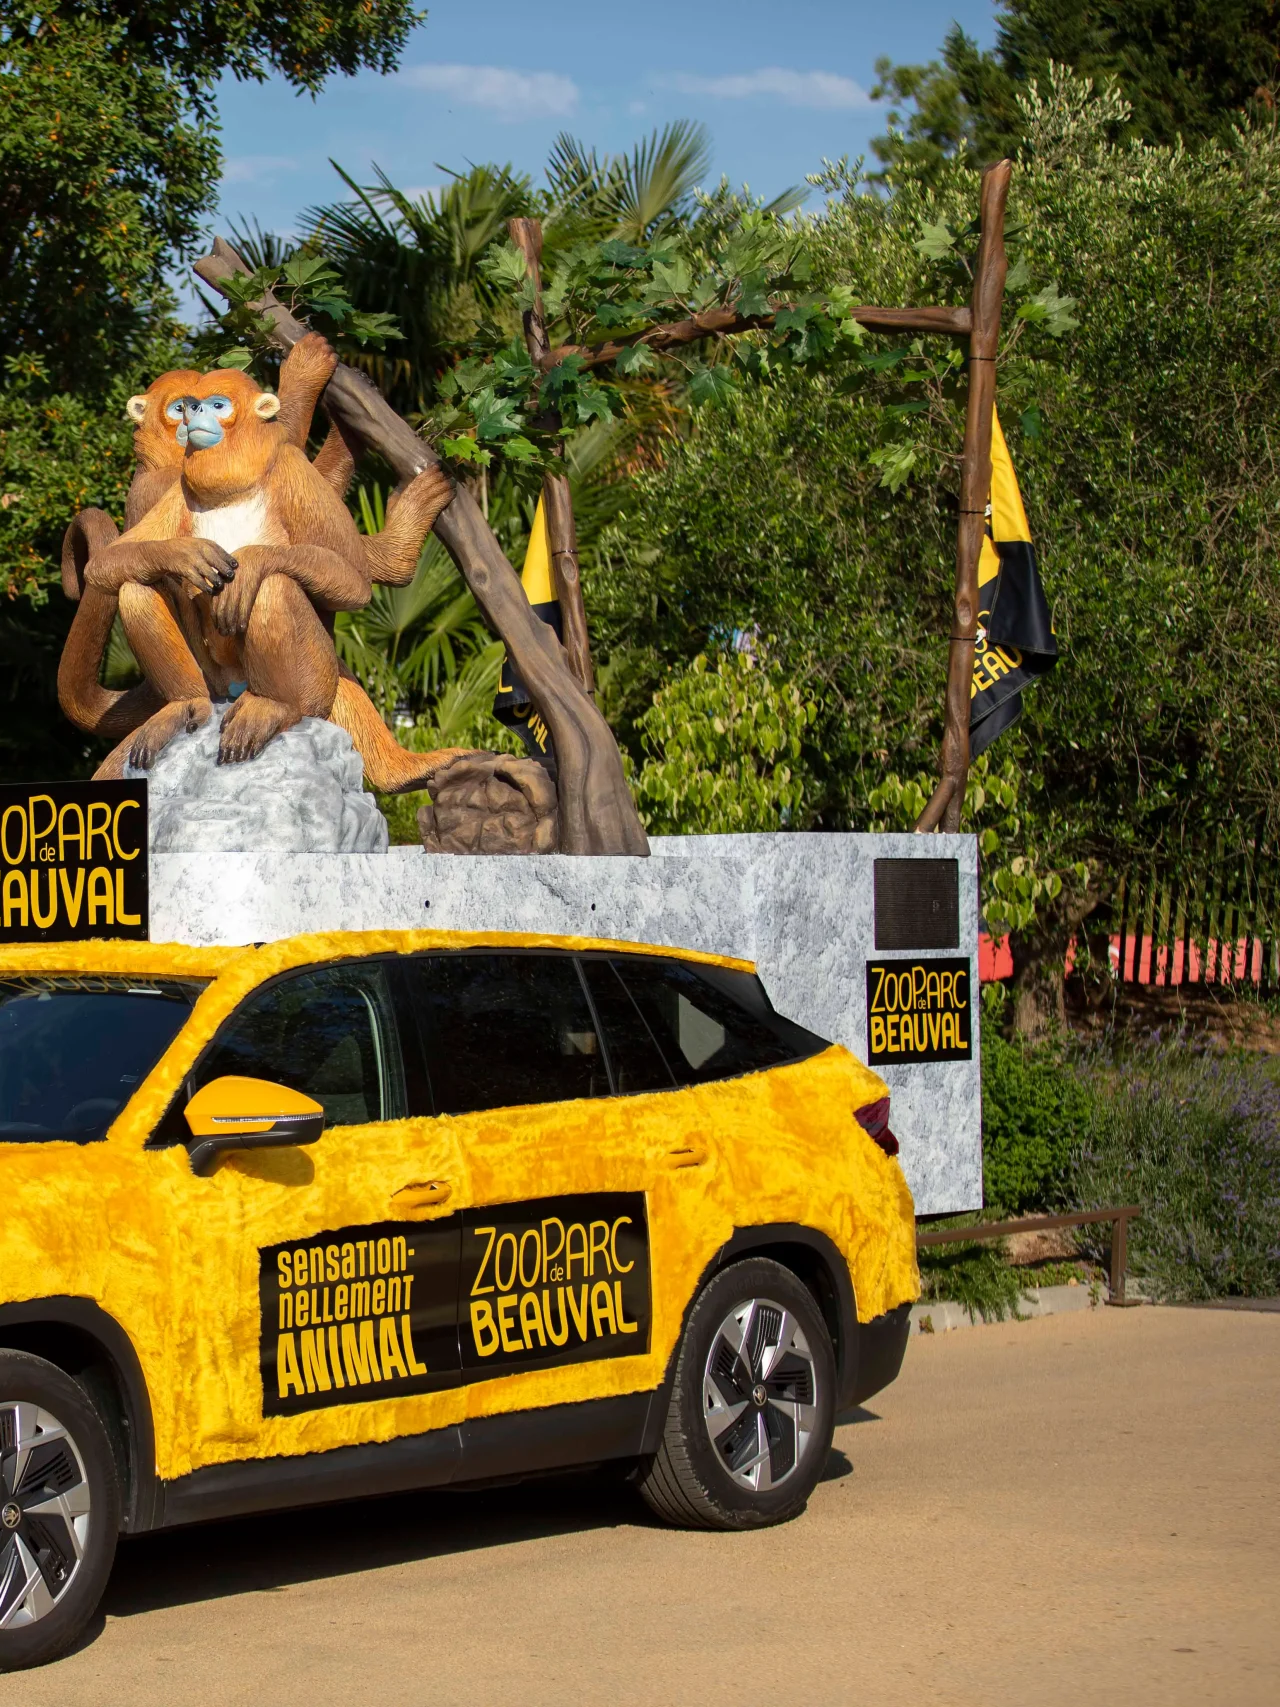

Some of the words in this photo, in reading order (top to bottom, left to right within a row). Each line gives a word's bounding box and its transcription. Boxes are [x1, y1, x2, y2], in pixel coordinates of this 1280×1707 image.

[39, 843, 56, 863] de
[870, 966, 967, 1012] ZOOPARC
[918, 996, 927, 1010] de
[870, 1012, 968, 1053] BEAUVAL
[470, 1216, 635, 1296] ZOOPARC
[549, 1263, 564, 1282] de
[470, 1280, 638, 1357] BEAUVAL
[277, 1314, 427, 1398] ANIMAL
